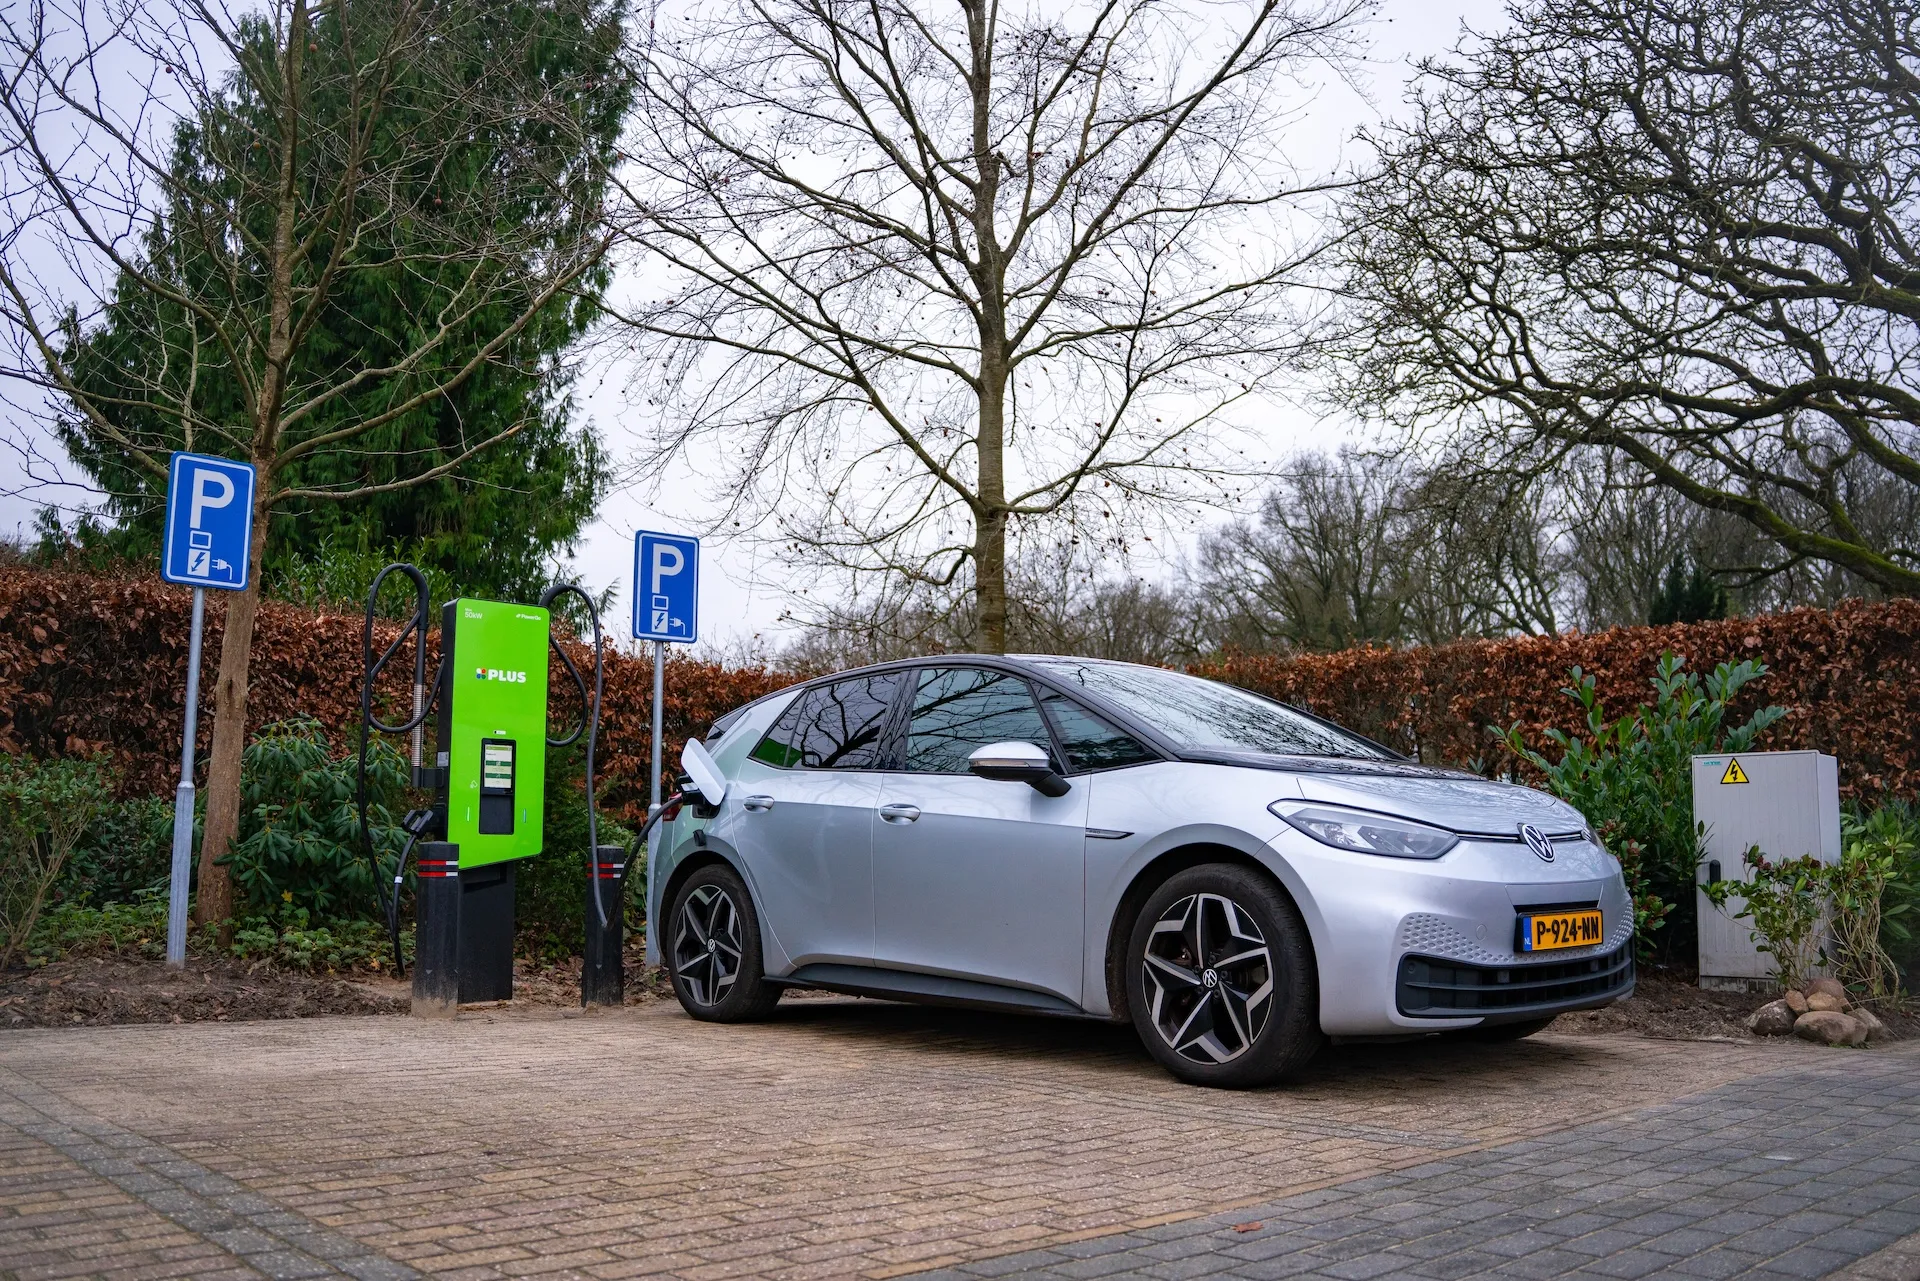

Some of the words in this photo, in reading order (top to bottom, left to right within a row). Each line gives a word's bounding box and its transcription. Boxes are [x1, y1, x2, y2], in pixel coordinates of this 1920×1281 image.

[190, 468, 235, 529] P
[652, 543, 685, 594] P
[488, 669, 527, 684] PLUS
[1524, 937, 1532, 945] NL
[1536, 916, 1599, 945] P-924-NN
